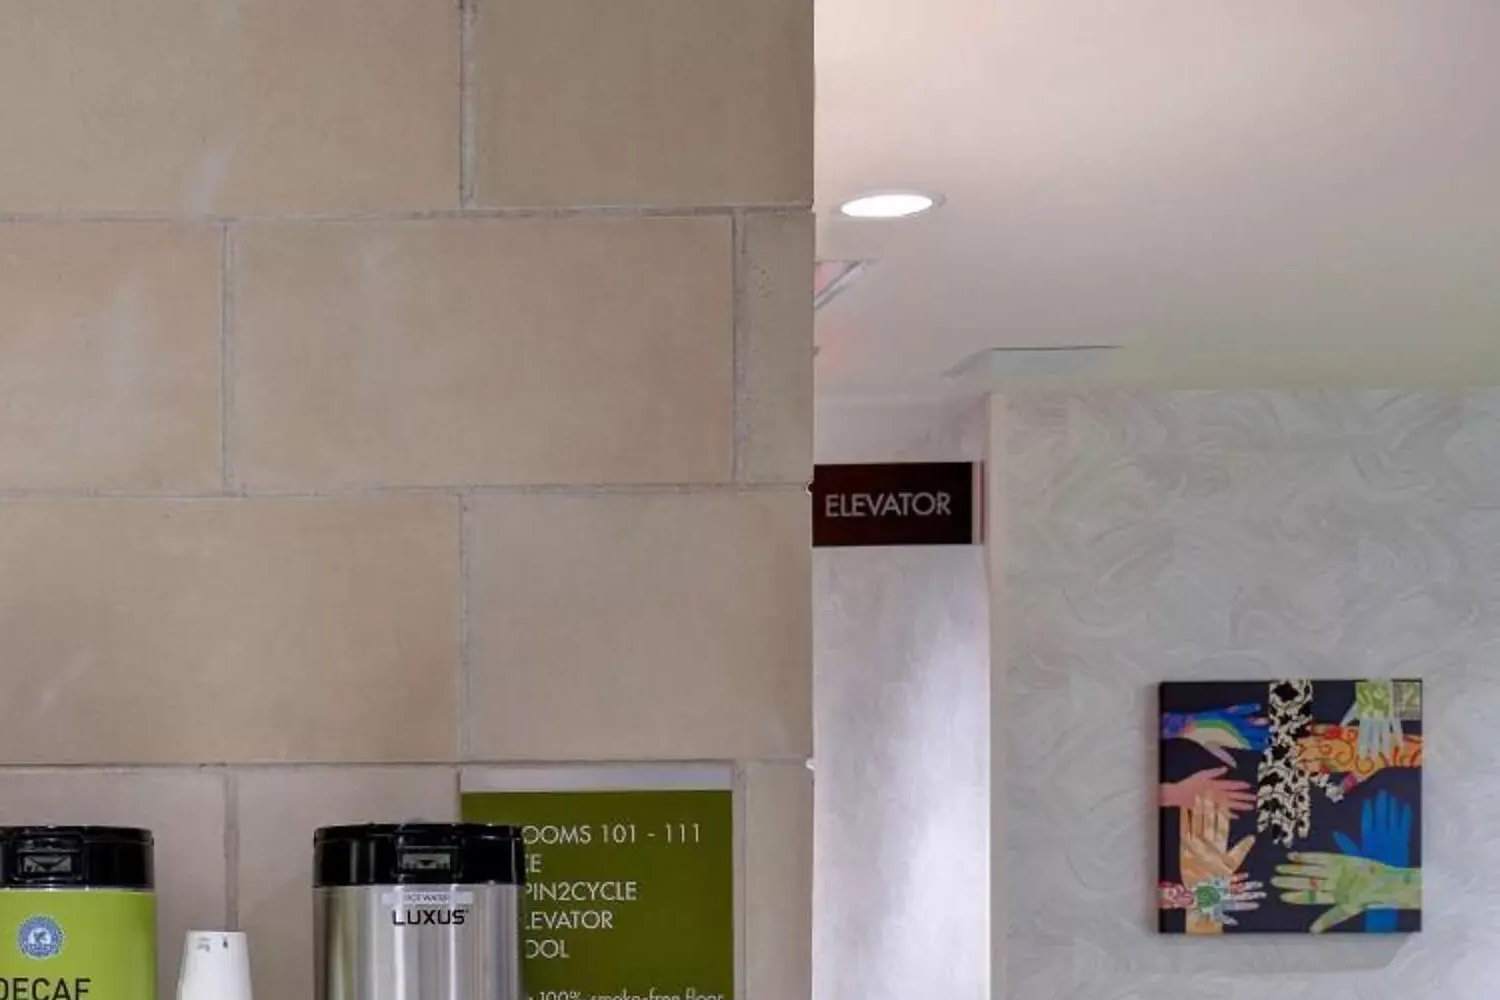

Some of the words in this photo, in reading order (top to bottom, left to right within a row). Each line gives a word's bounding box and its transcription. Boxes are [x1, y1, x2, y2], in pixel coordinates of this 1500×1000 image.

[825, 491, 951, 517] ELEVATOR
[521, 825, 592, 845] OOMS
[601, 824, 636, 844] 101
[666, 823, 700, 843] 111
[526, 881, 637, 901] IN2CYCLE
[392, 909, 466, 925] LUXUS
[525, 911, 613, 930] EVATOR
[525, 940, 570, 958] OOL
